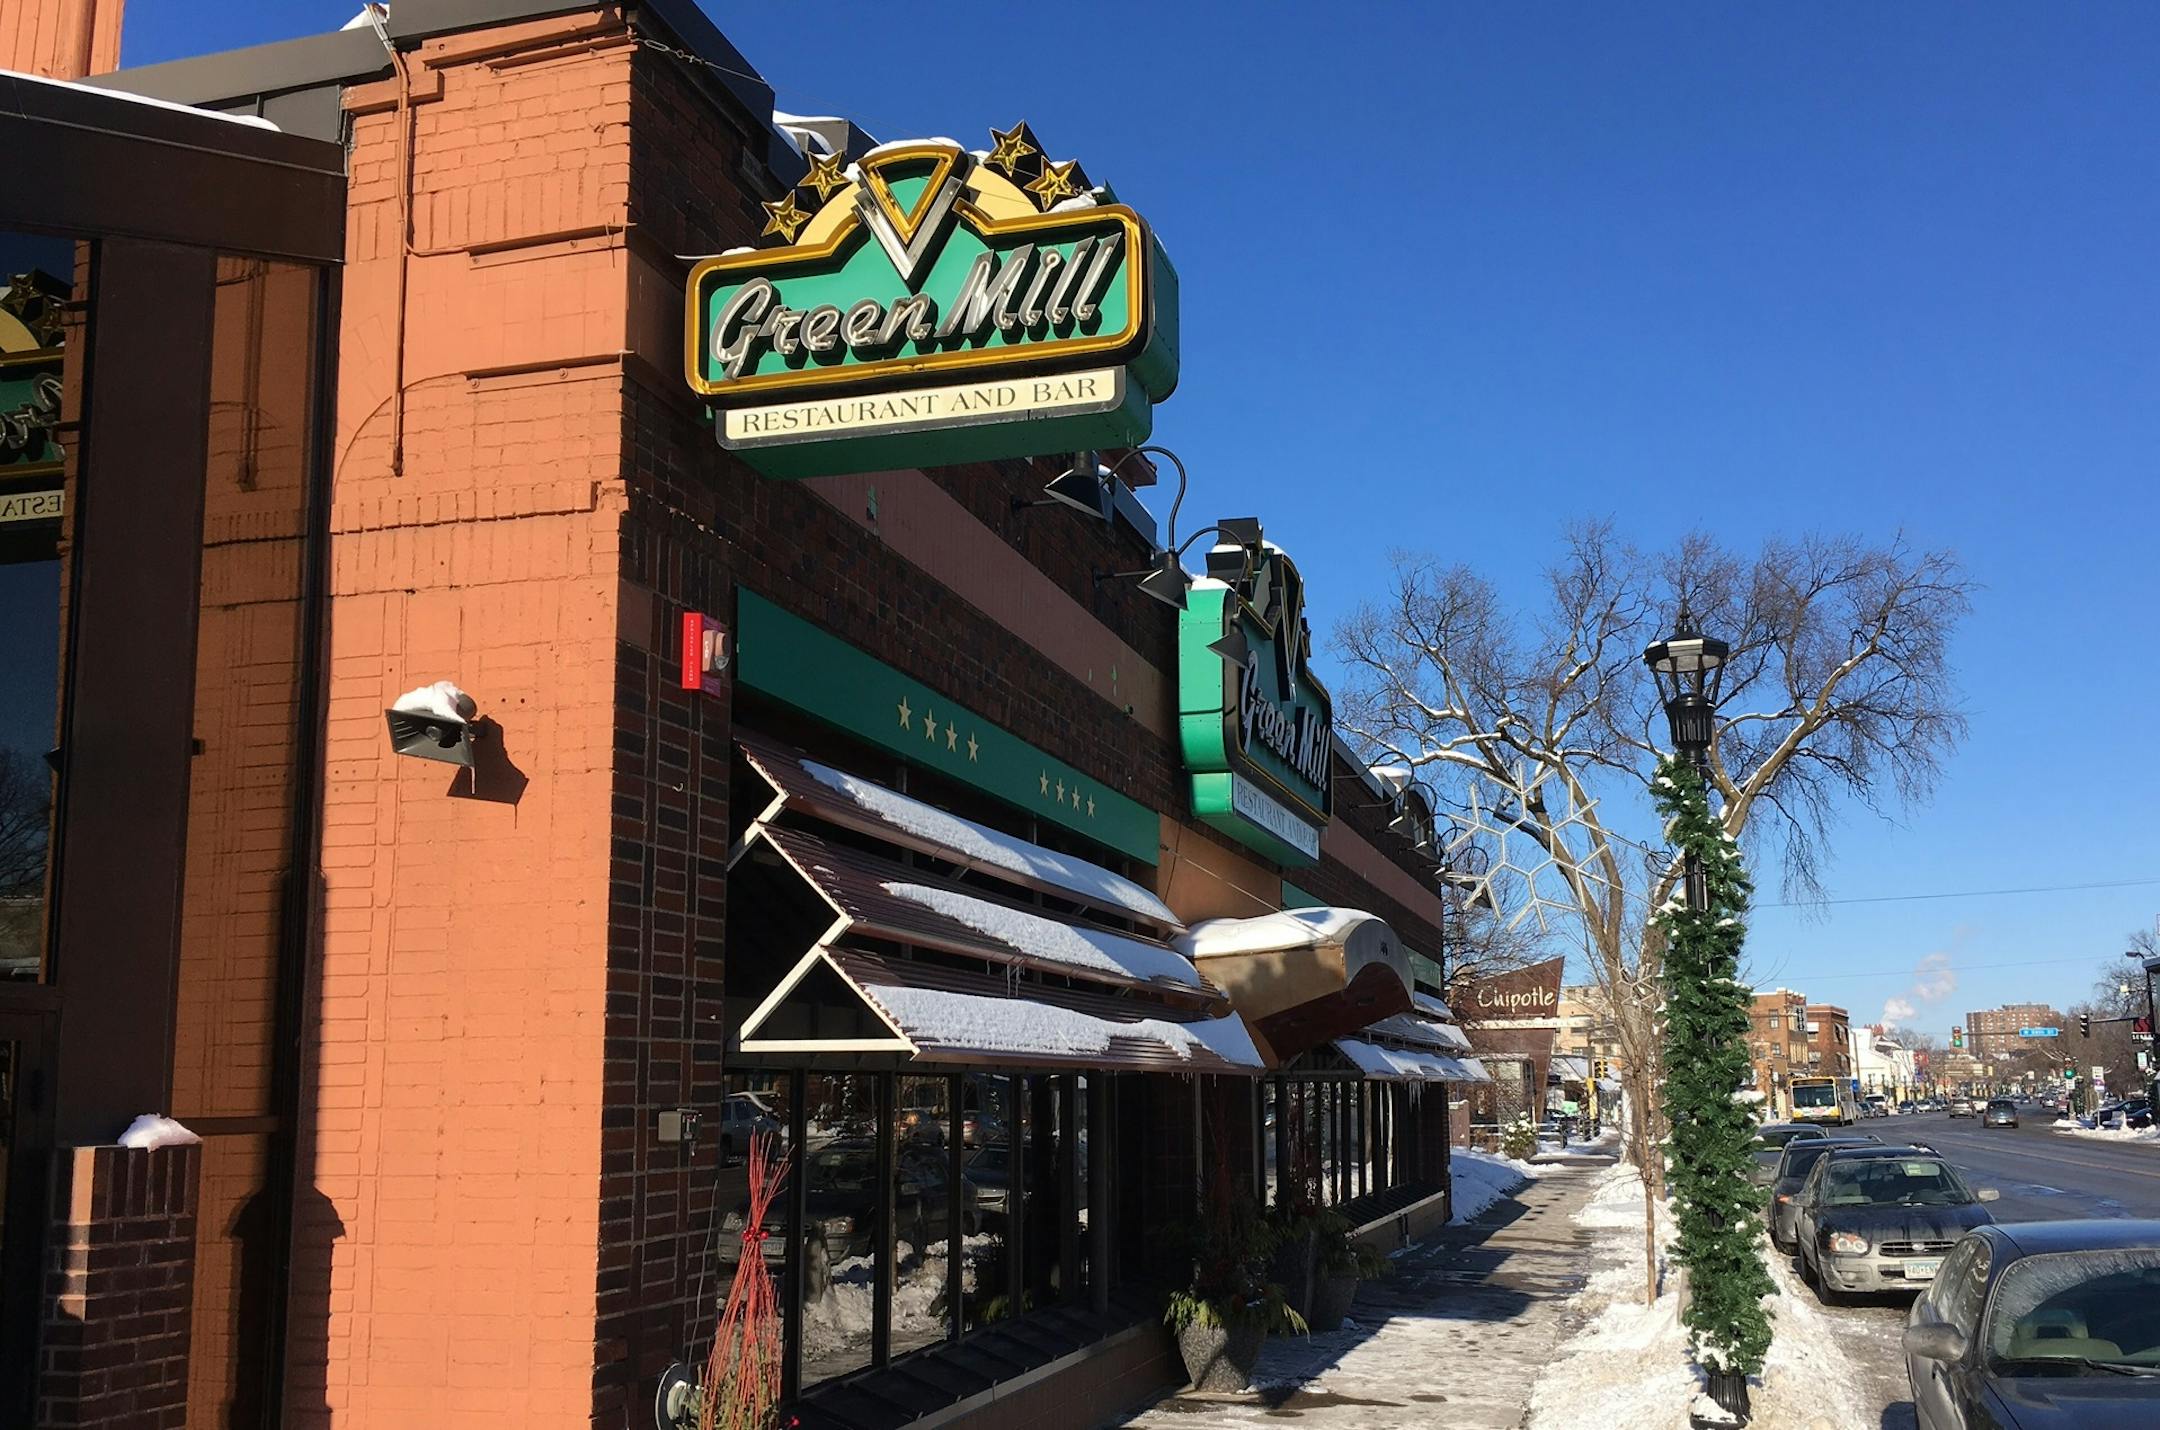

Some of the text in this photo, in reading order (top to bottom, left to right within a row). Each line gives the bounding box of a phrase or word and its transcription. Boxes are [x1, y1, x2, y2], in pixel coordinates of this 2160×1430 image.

[709, 232, 1122, 380] Green Mill
[742, 377, 1097, 434] RESTAURANT AND BAR
[1241, 650, 1331, 792] Green Mill
[1237, 781, 1286, 833] RESTAURANT
[1478, 985, 1555, 1013] Chipotle
